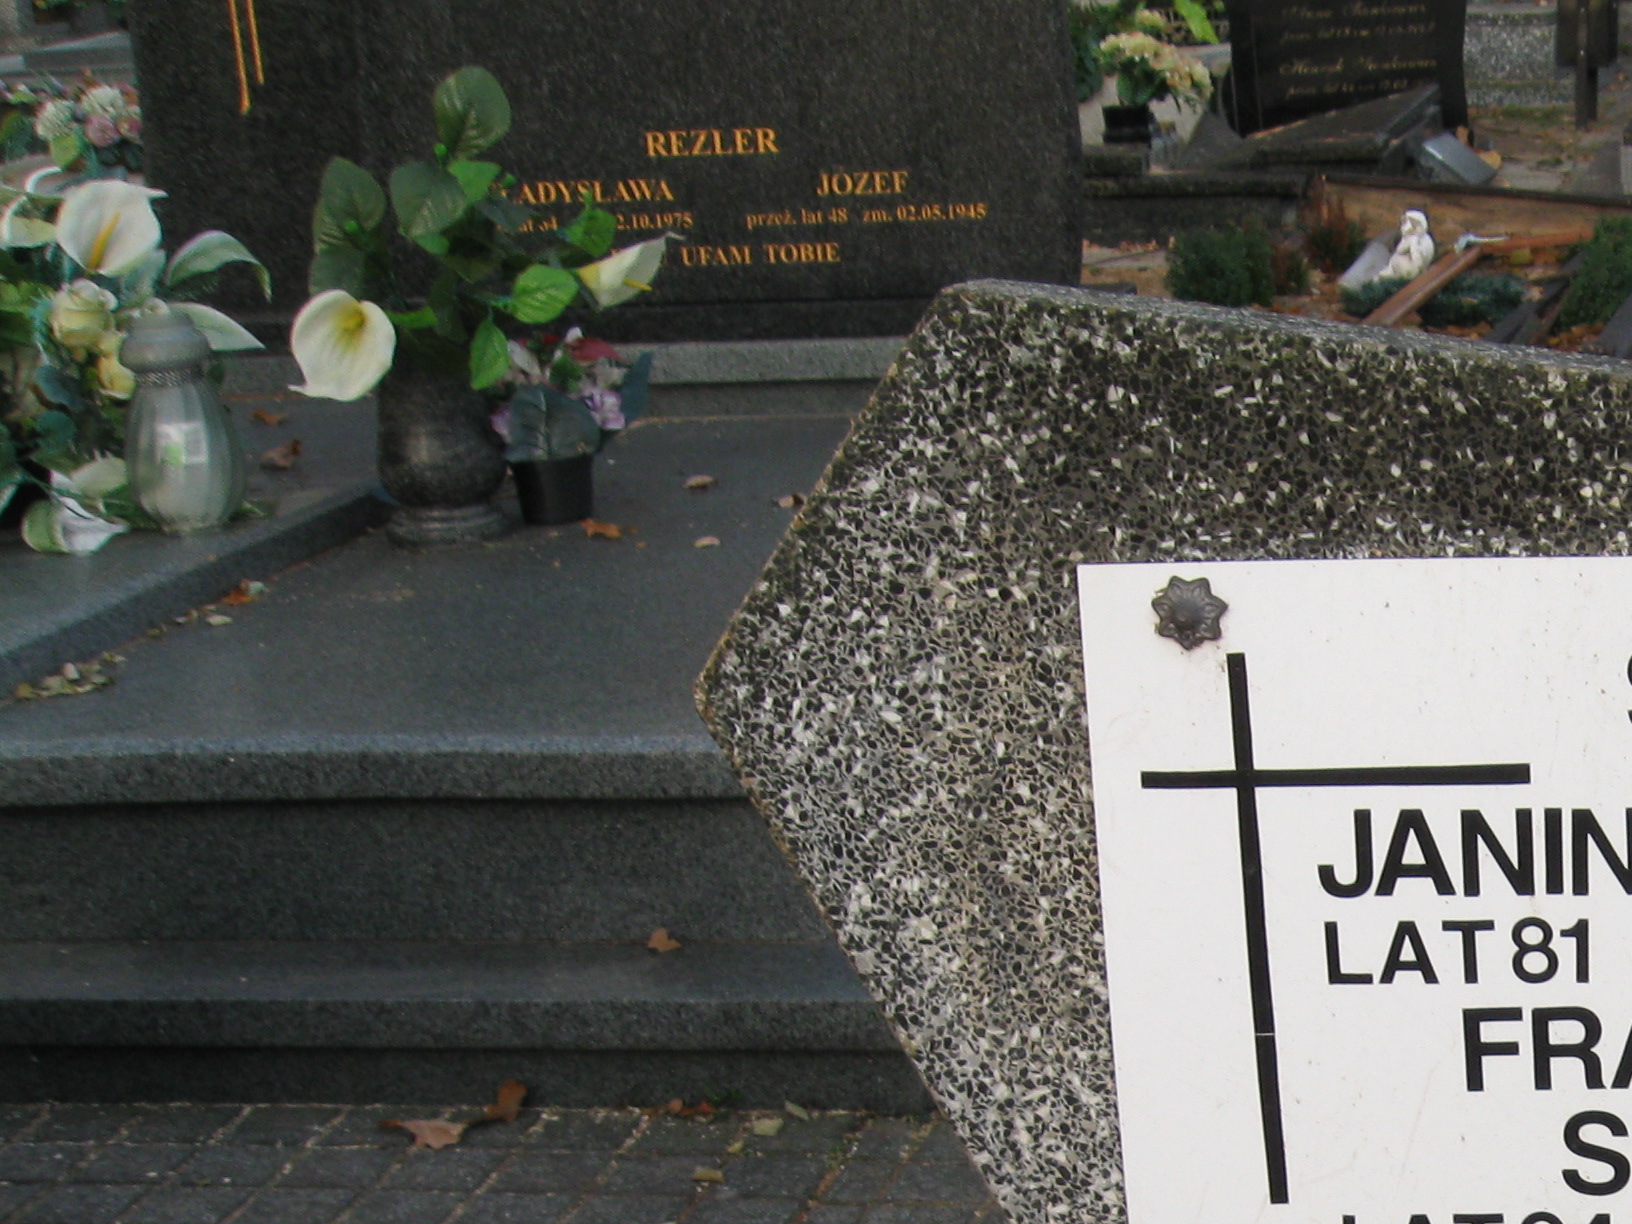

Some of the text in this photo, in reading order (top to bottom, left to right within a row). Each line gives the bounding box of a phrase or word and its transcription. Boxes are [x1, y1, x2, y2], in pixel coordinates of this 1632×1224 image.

[645, 128, 779, 157] REZLER
[816, 166, 909, 197] JÓZEF
[616, 212, 694, 230] 2.10.1975
[801, 208, 823, 226] lat
[827, 207, 849, 225] 48
[680, 244, 752, 267] UFAM
[763, 242, 841, 265] TOBIE
[1324, 919, 1495, 985] LAT
[1511, 916, 1589, 984] 81
